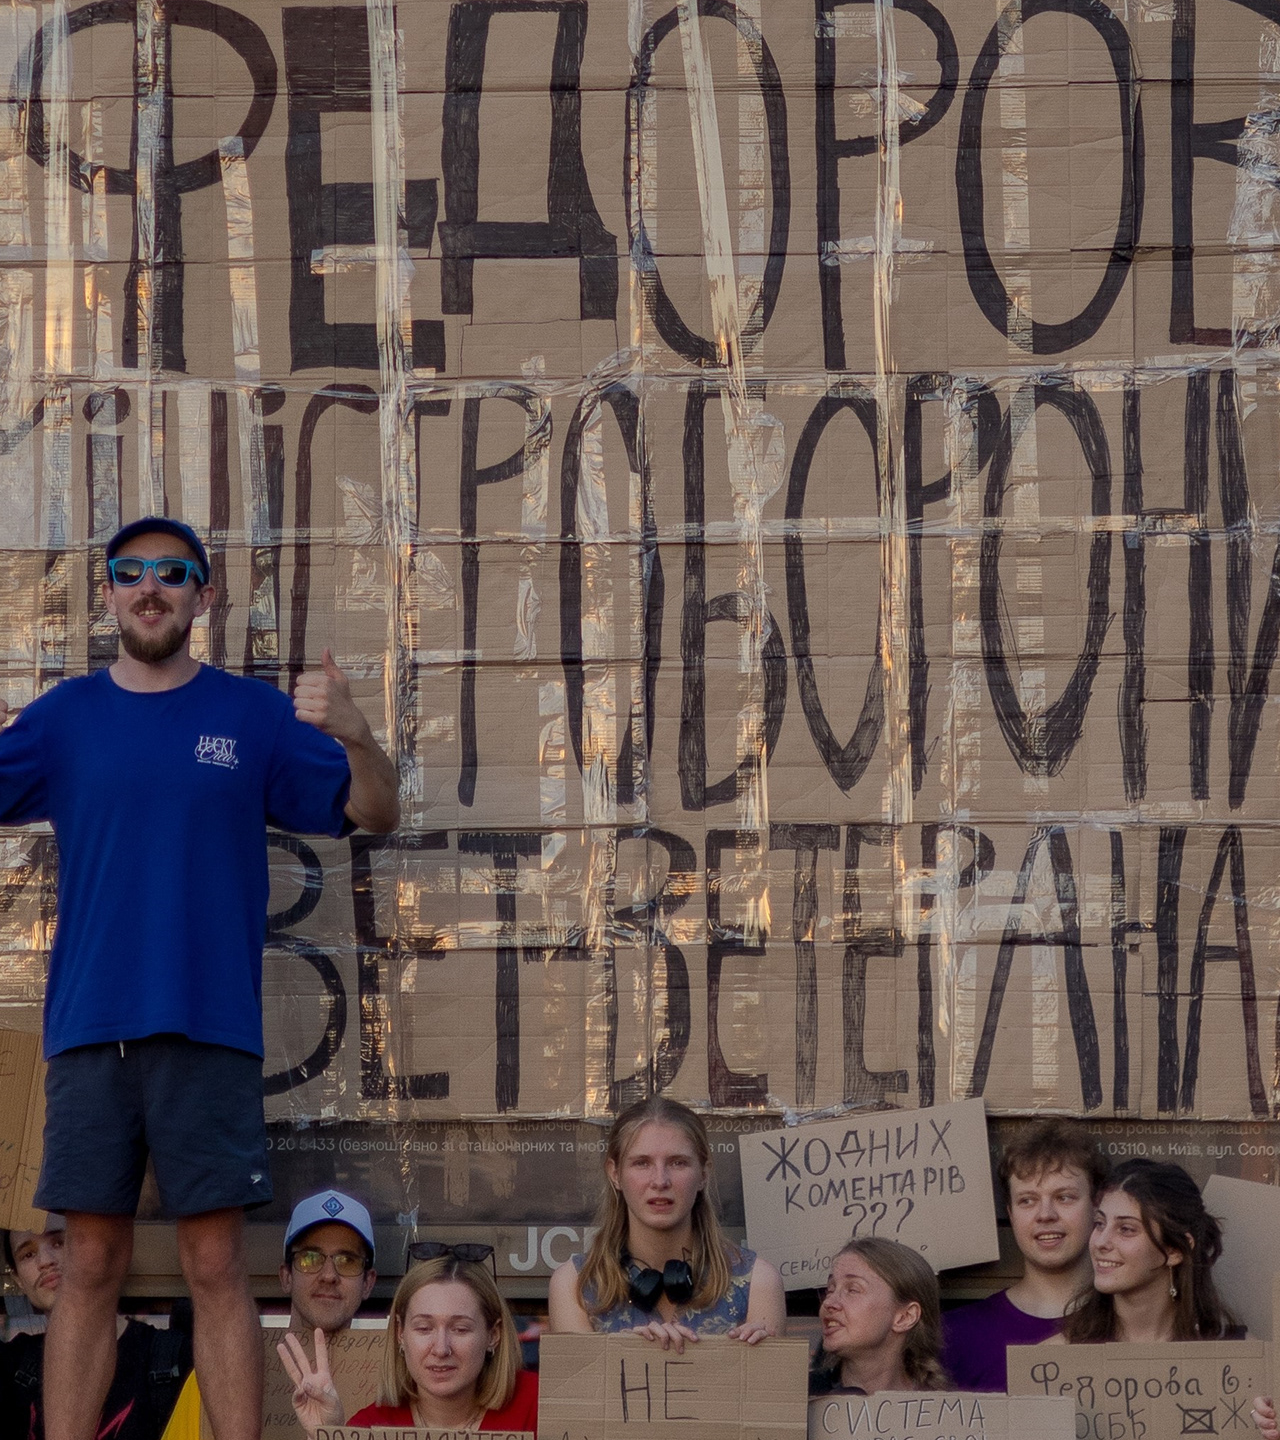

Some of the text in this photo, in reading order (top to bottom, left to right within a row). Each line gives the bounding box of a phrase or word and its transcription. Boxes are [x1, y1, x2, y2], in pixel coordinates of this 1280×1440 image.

[198, 736, 236, 756] LUCKY
[299, 1138, 335, 1152] 5433
[559, 1141, 575, 1152] та
[761, 1118, 952, 1182] ЖОДНИХ
[1108, 1142, 1149, 1157] 03110,
[1169, 1142, 1202, 1158] Київ,
[1207, 1143, 1235, 1158] вул.
[784, 1165, 966, 1214] КОМЕНТАРІВ
[621, 1358, 699, 1423] НЕ
[1031, 1361, 1203, 1416] Федорова
[822, 1398, 986, 1435] СИСТЕМА
